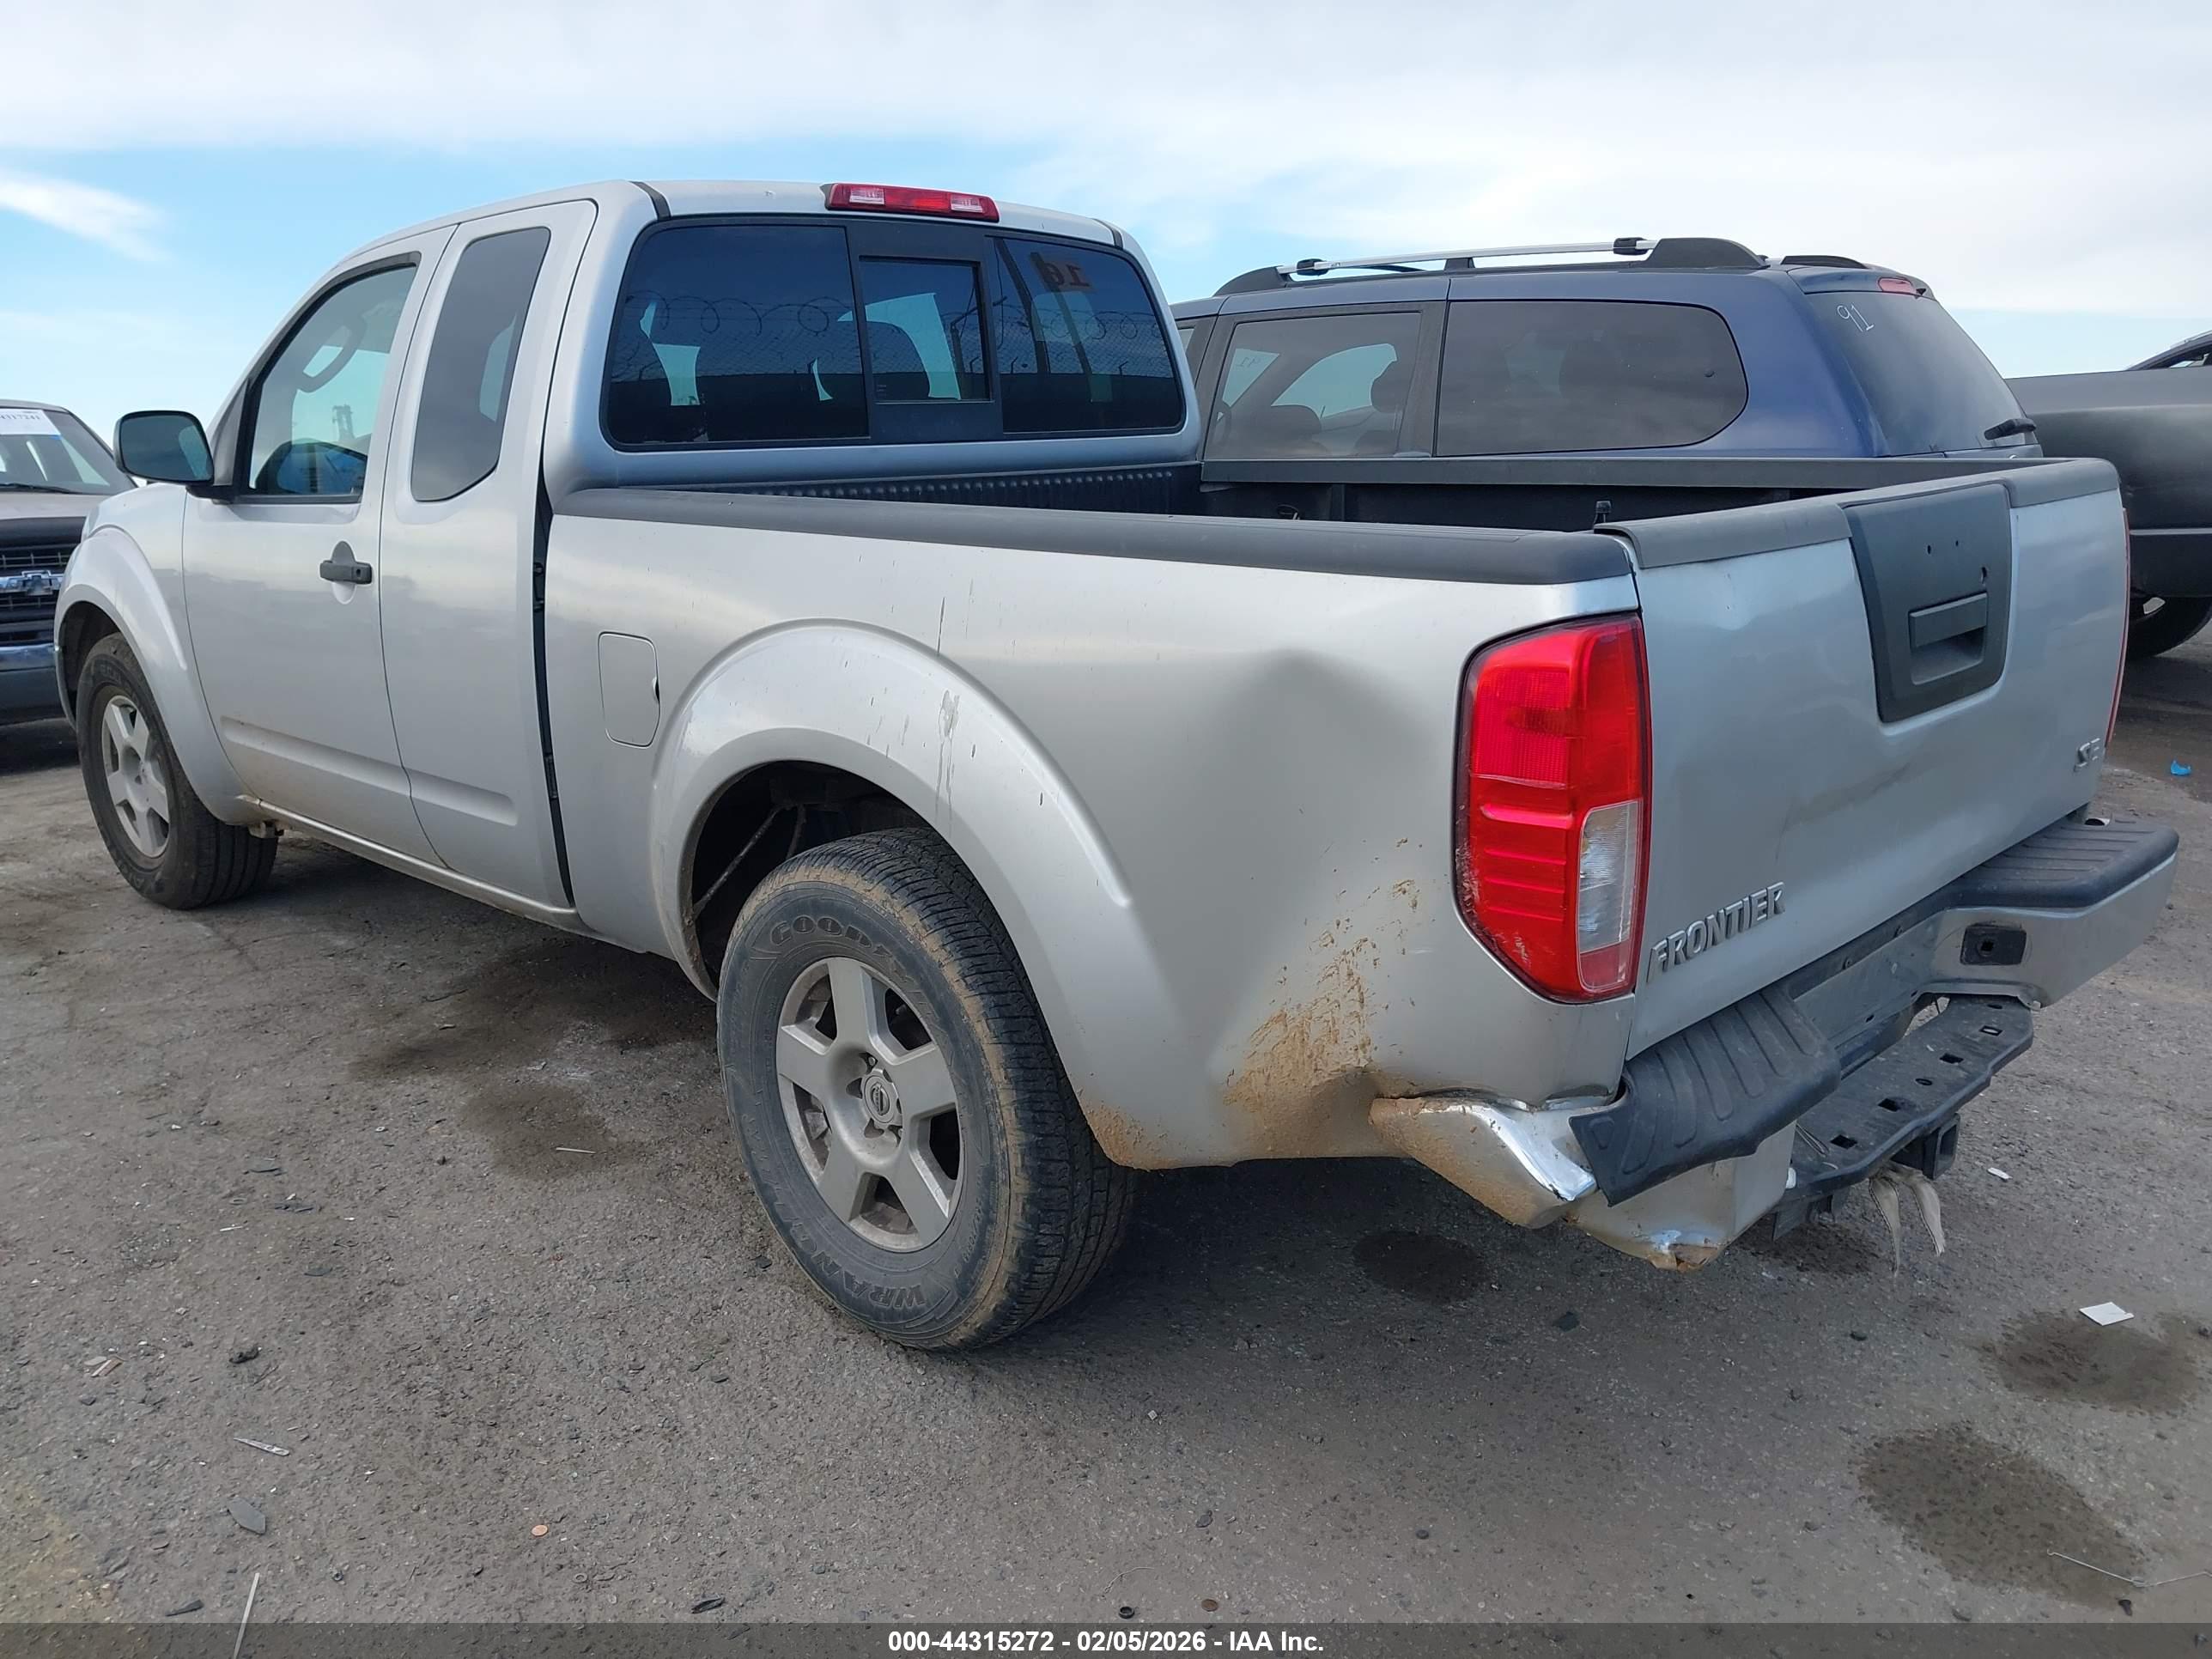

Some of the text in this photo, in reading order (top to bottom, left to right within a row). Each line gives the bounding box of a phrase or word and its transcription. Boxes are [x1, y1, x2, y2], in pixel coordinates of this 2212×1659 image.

[1837, 302, 1875, 332] 91
[2073, 738, 2100, 772] SE
[1646, 881, 1785, 982] FRONTIER
